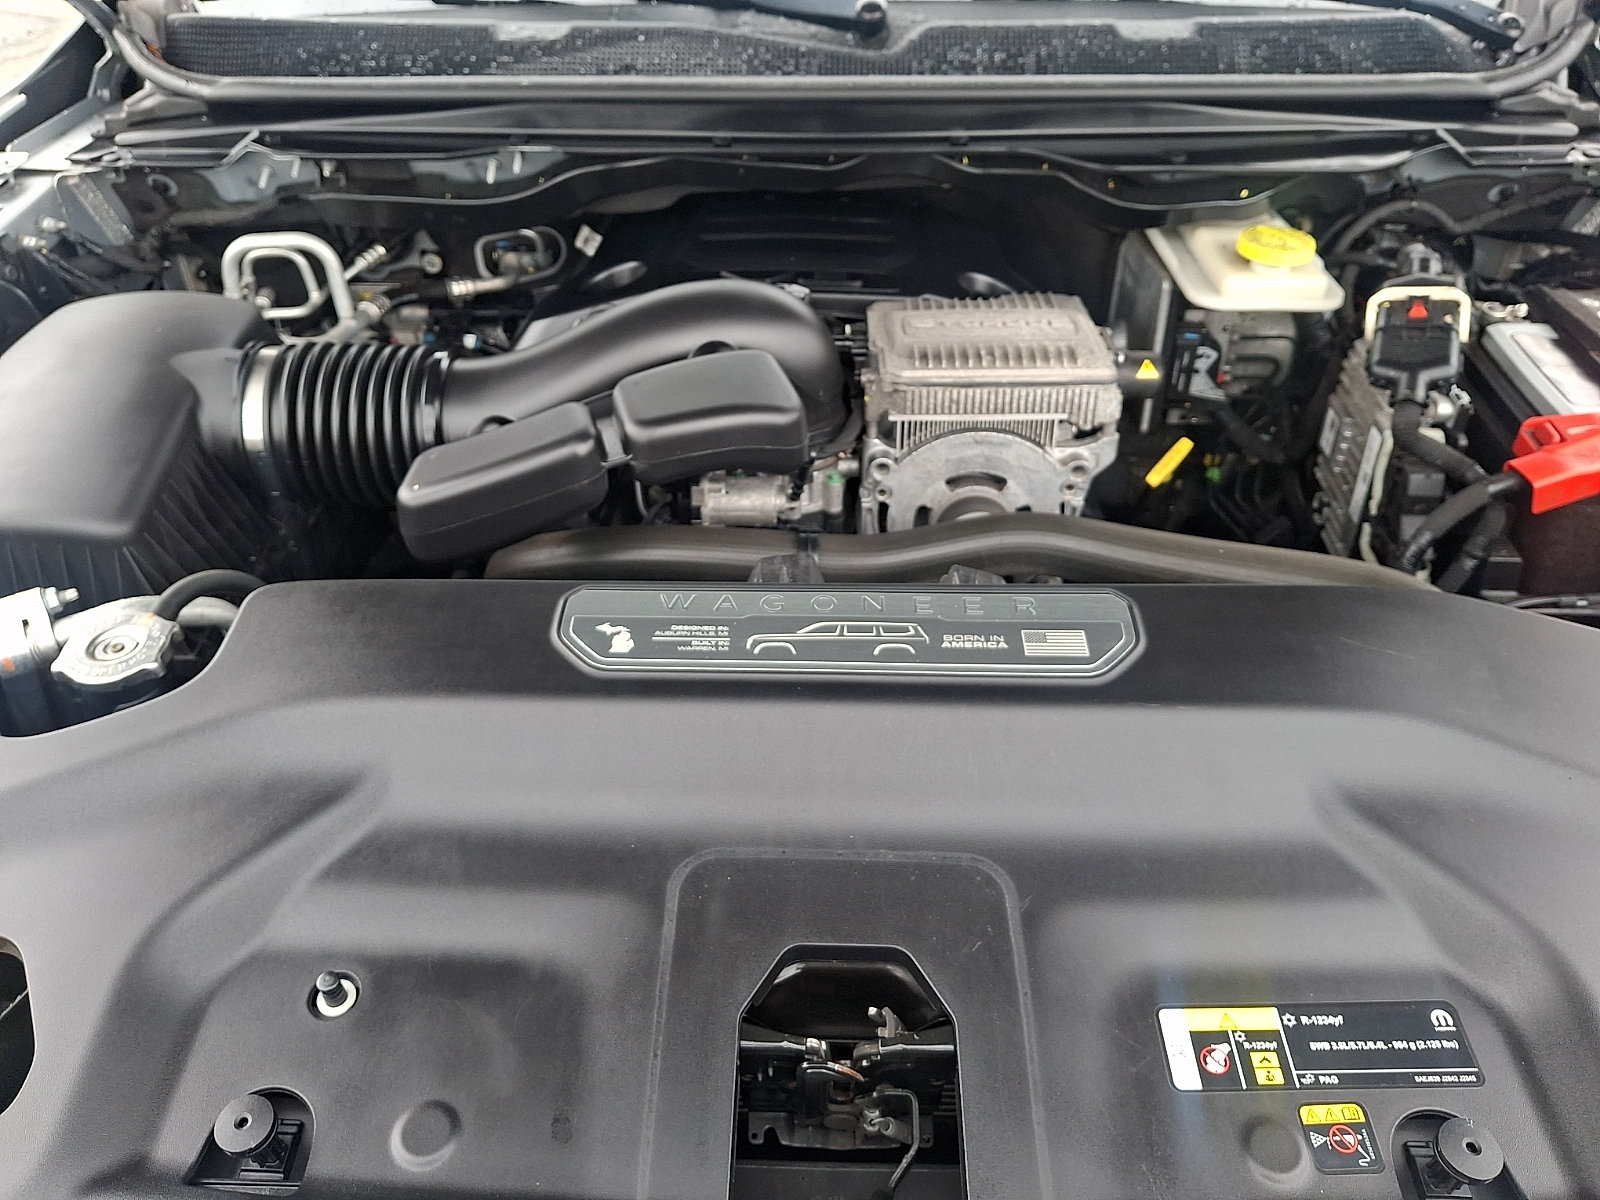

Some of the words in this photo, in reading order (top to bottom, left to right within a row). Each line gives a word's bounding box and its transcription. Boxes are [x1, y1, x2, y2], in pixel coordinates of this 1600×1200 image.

[659, 593, 1036, 616] WAGONEER
[942, 634, 985, 642] BORN
[990, 634, 1004, 642] IN
[940, 641, 1008, 649] AMERICA
